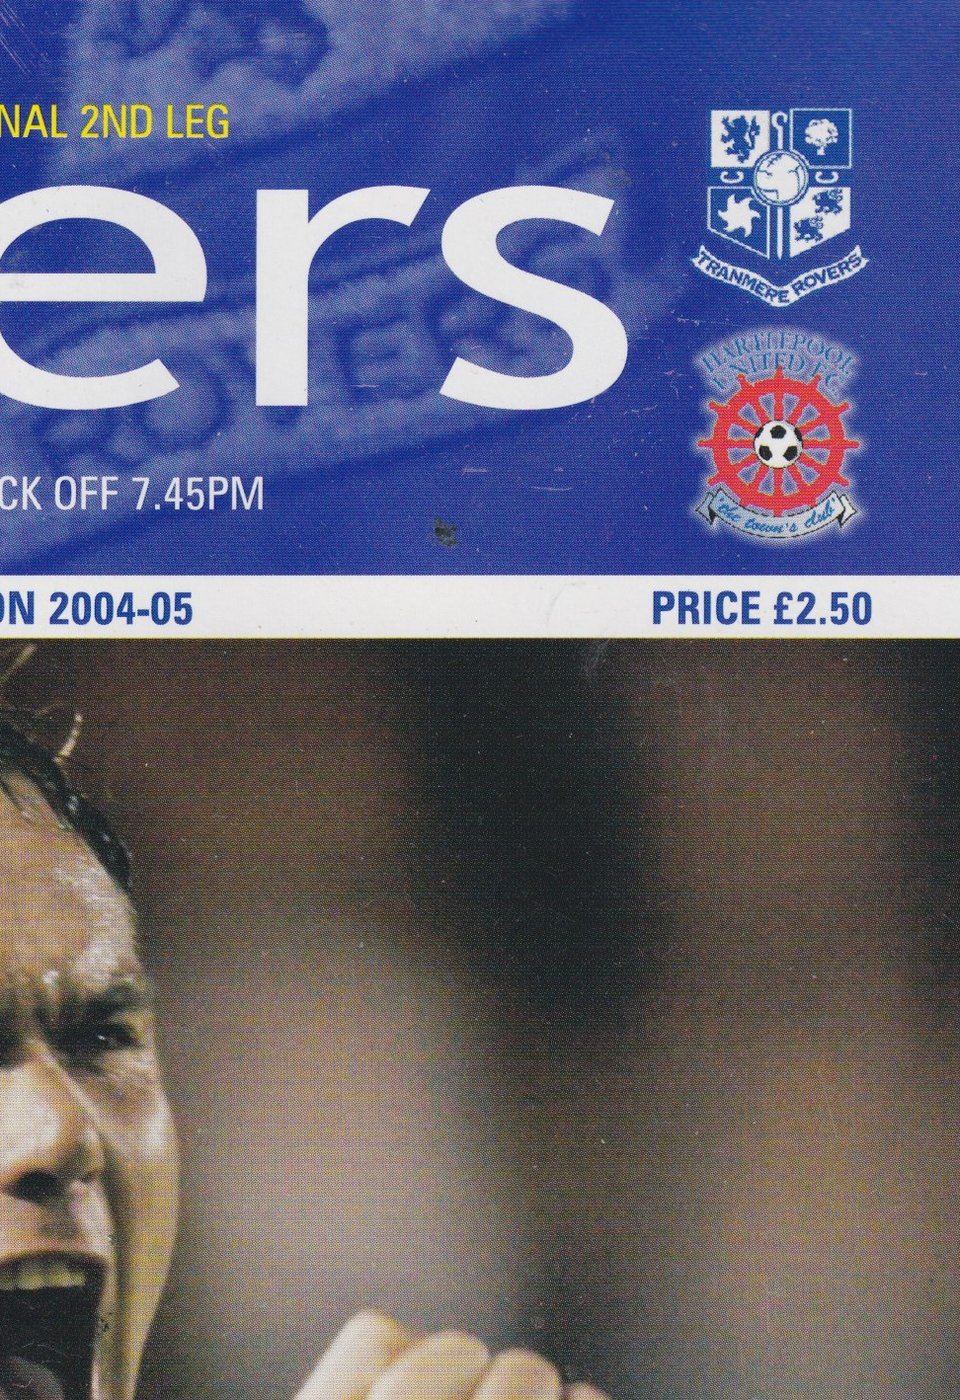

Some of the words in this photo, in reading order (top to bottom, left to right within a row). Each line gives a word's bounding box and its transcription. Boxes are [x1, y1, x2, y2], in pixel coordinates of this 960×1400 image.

[81, 104, 153, 138] 2ND
[167, 104, 229, 138] LEG
[698, 251, 790, 303] TRANMERE
[791, 253, 863, 296] ROVERS
[701, 330, 855, 376] HARTLEPOOL
[711, 351, 807, 391] UNITED
[54, 476, 119, 510] OFF
[131, 476, 264, 510] 7.45PM
[744, 517, 799, 534] town's
[49, 591, 193, 625] 2004-05
[653, 591, 761, 625] PRICE
[773, 591, 872, 626] £2.50
